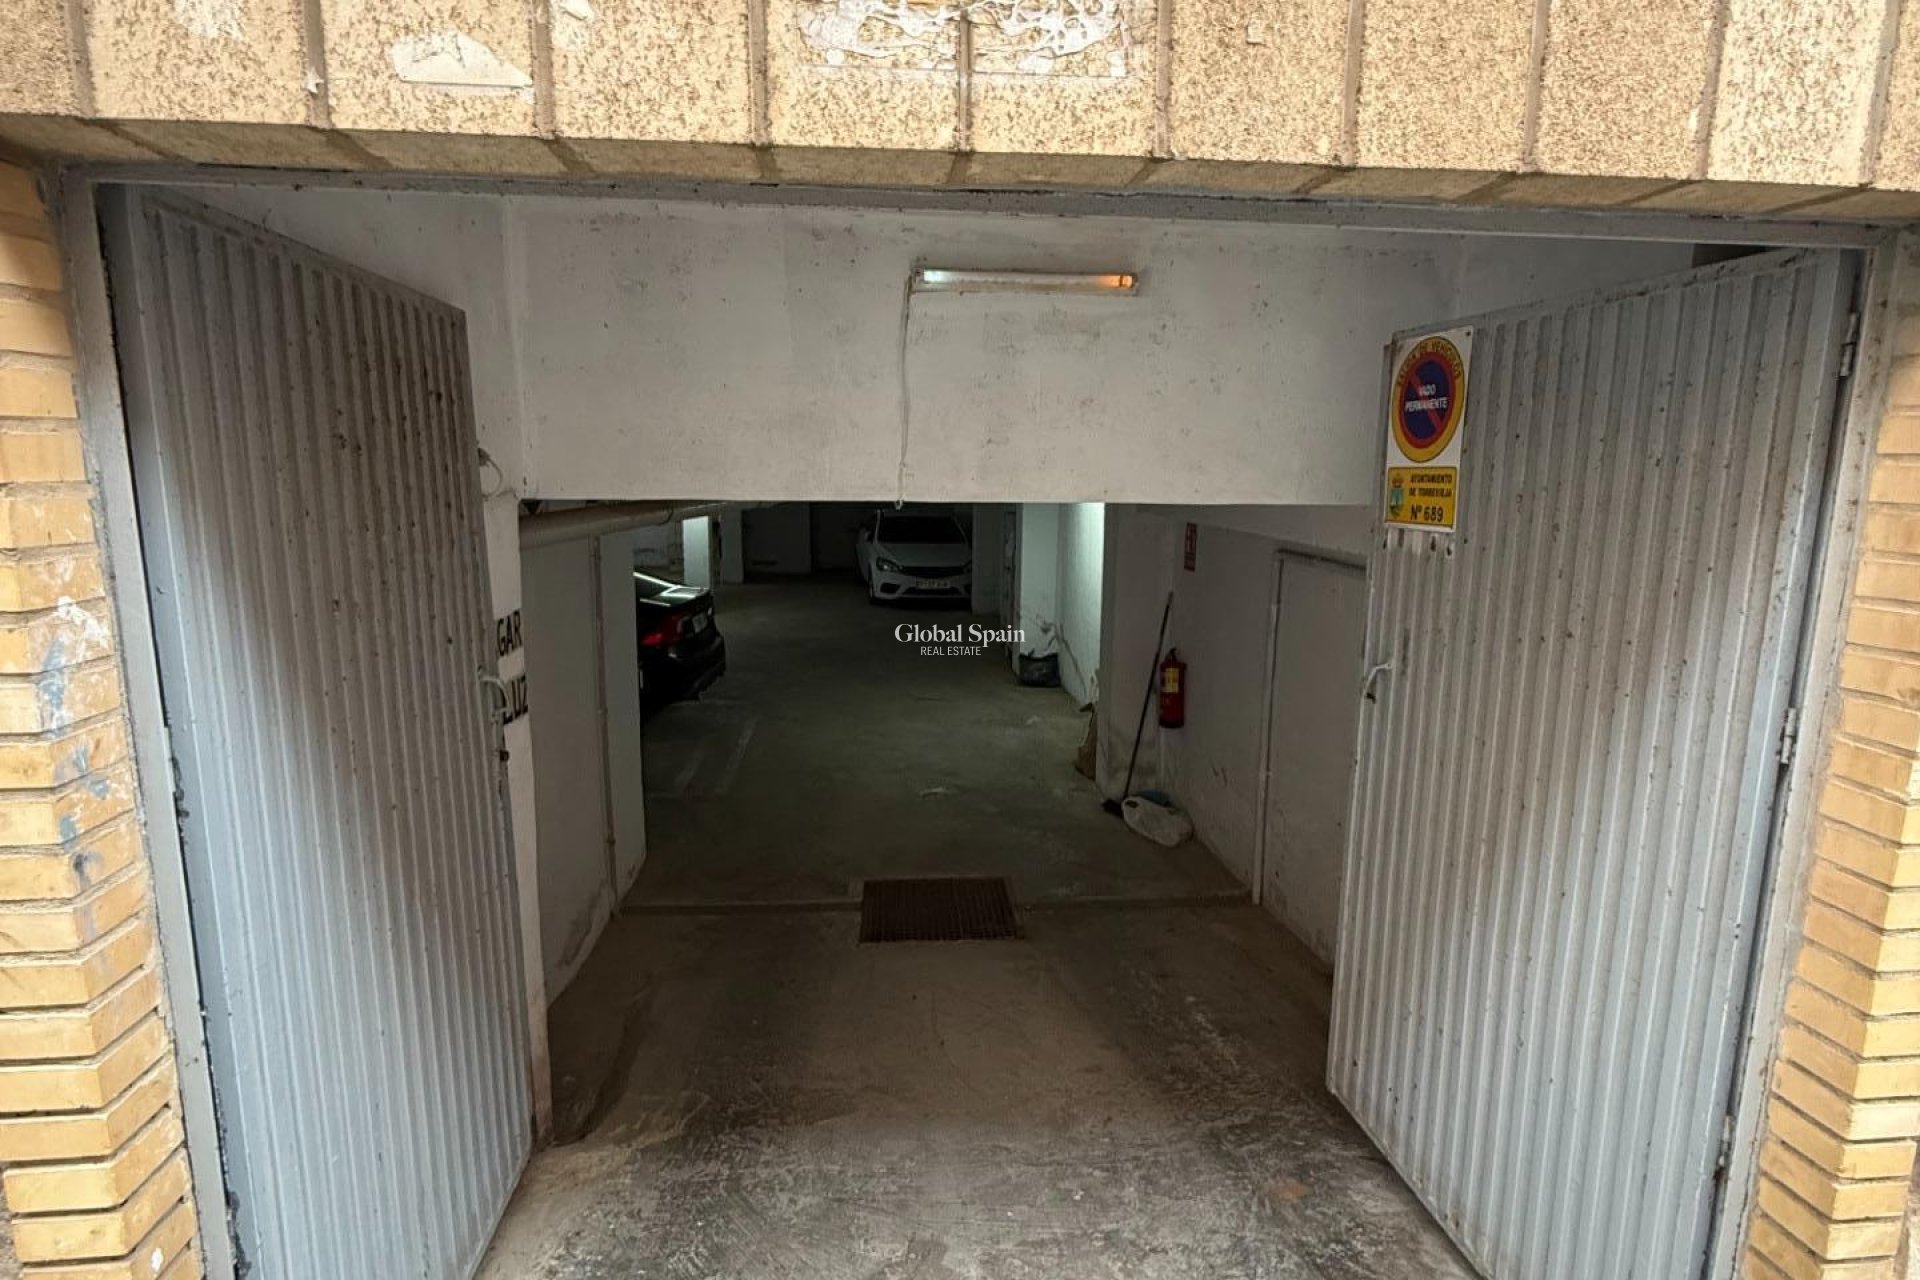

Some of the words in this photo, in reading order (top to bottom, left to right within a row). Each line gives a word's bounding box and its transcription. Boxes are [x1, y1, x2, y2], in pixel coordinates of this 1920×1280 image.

[1418, 384, 1437, 396] VADO
[1404, 397, 1449, 413] PERMANENTE
[1423, 505, 1444, 522] 689
